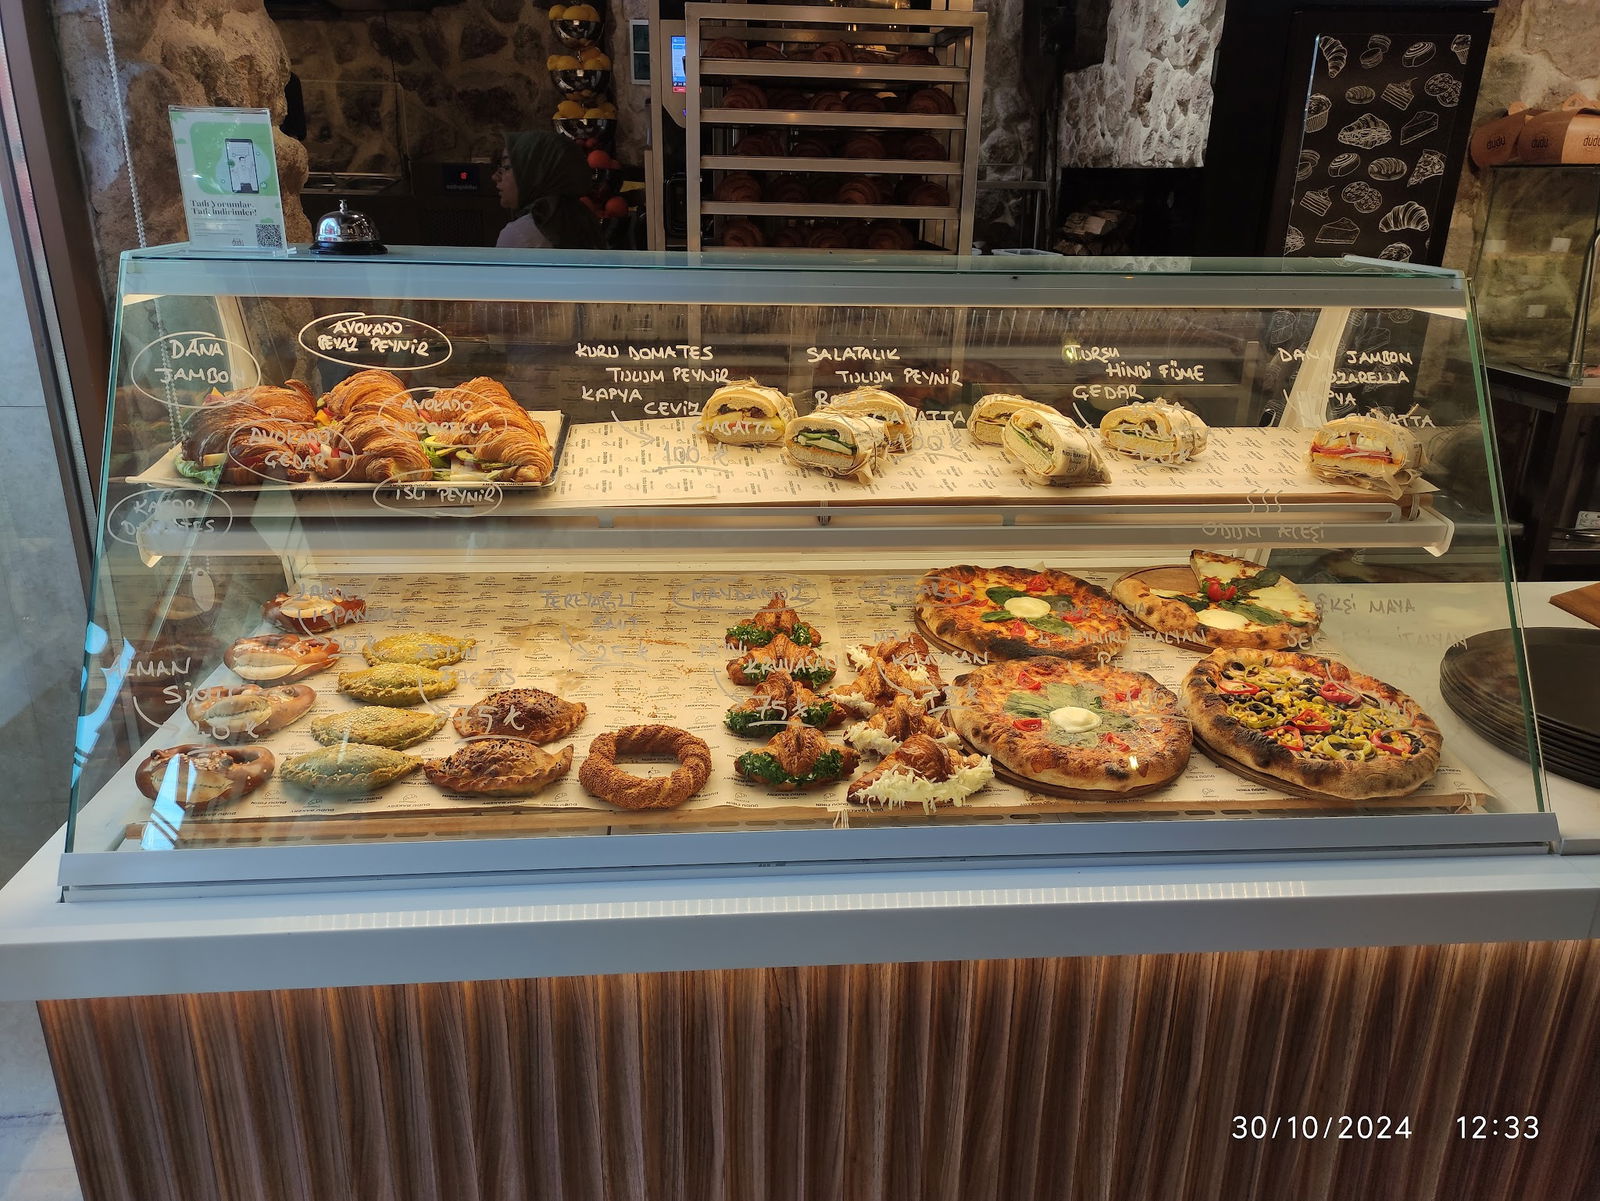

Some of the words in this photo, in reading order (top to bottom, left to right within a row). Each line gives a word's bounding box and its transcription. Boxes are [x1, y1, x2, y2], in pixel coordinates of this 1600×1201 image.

[332, 320, 403, 336] AVOKADO
[169, 338, 224, 359] DANA
[575, 342, 619, 358] KURU
[628, 344, 714, 361] DOMATES
[806, 346, 901, 362] SALATALIK
[1346, 350, 1413, 365] JAMBON
[154, 367, 238, 384] JAMBO
[1158, 360, 1205, 382] FÜME
[581, 385, 643, 403] KAPYA
[401, 397, 473, 413] AVOKADO
[663, 440, 700, 465] 100
[1368, 598, 1416, 615] MAYA
